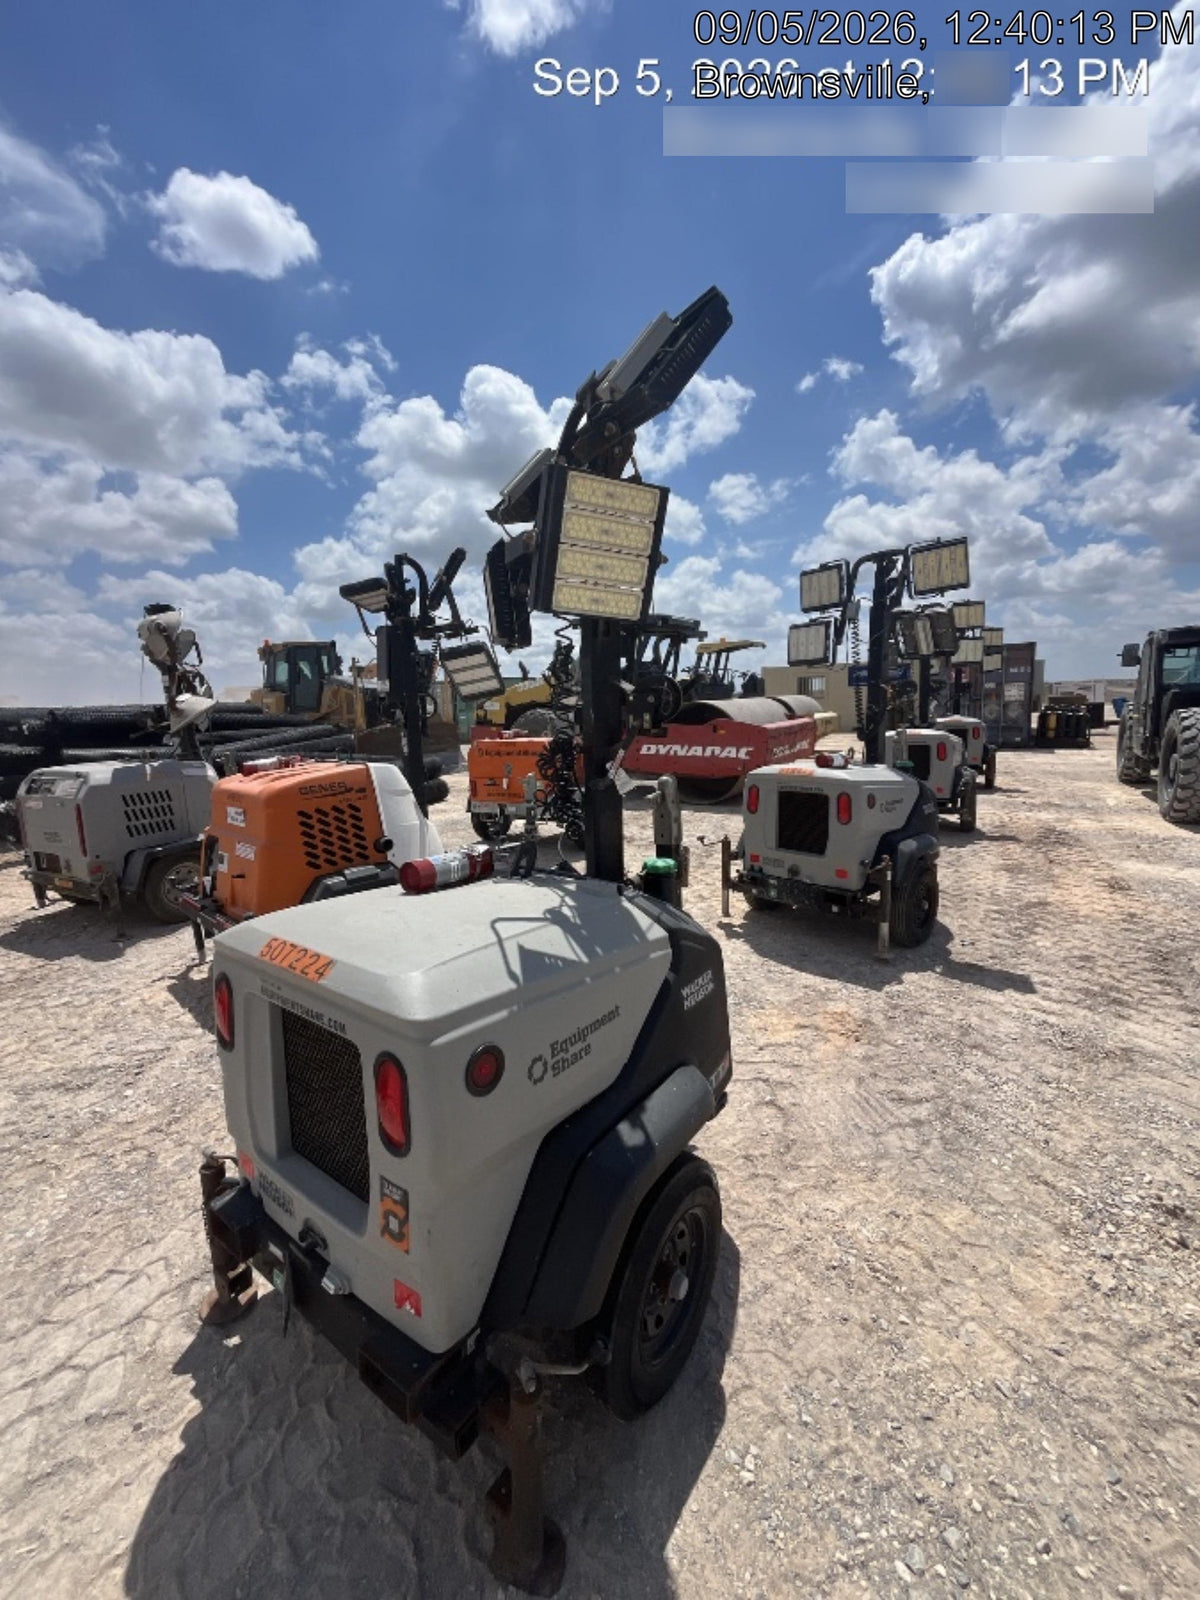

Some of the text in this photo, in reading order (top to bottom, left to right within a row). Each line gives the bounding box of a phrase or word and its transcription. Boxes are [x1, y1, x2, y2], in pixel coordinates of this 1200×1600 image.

[260, 938, 334, 981] 507224
[549, 1004, 621, 1060] Equipment
[551, 1043, 592, 1077] Share
